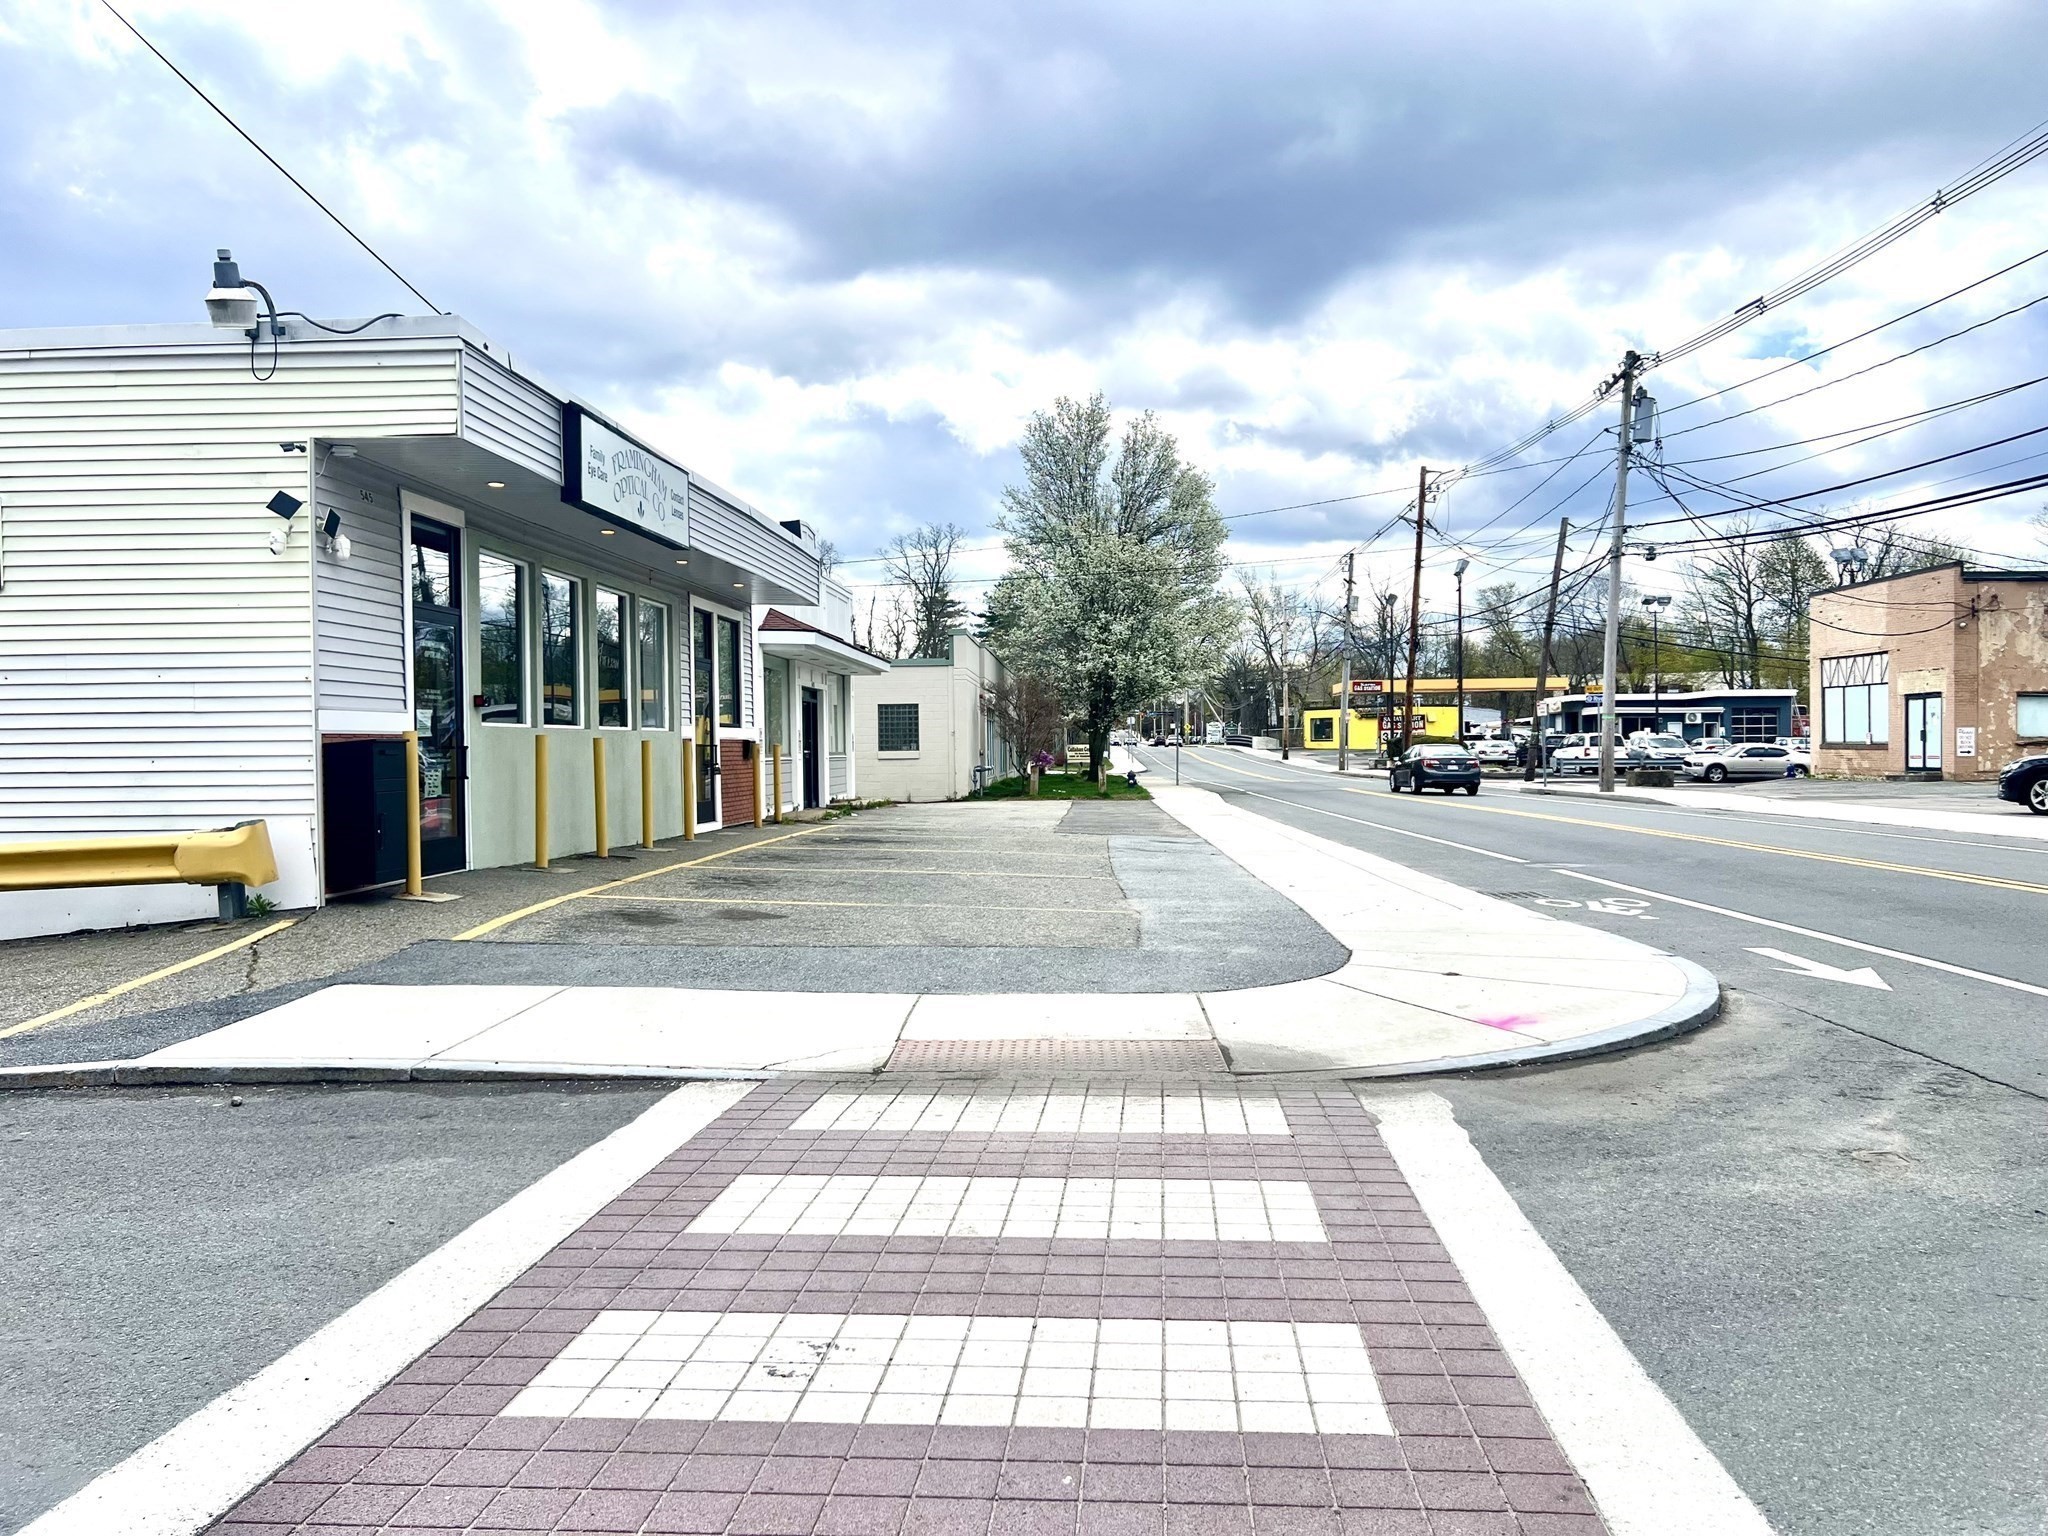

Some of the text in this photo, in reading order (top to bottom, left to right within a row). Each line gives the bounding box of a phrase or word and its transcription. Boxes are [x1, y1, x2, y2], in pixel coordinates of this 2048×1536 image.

[590, 445, 605, 466] Family
[588, 462, 608, 482] Eye Care
[612, 449, 667, 501] FRAMINGHAM
[614, 475, 649, 503] OPTICAL
[671, 489, 684, 506] Contact
[672, 506, 684, 521] Lenses
